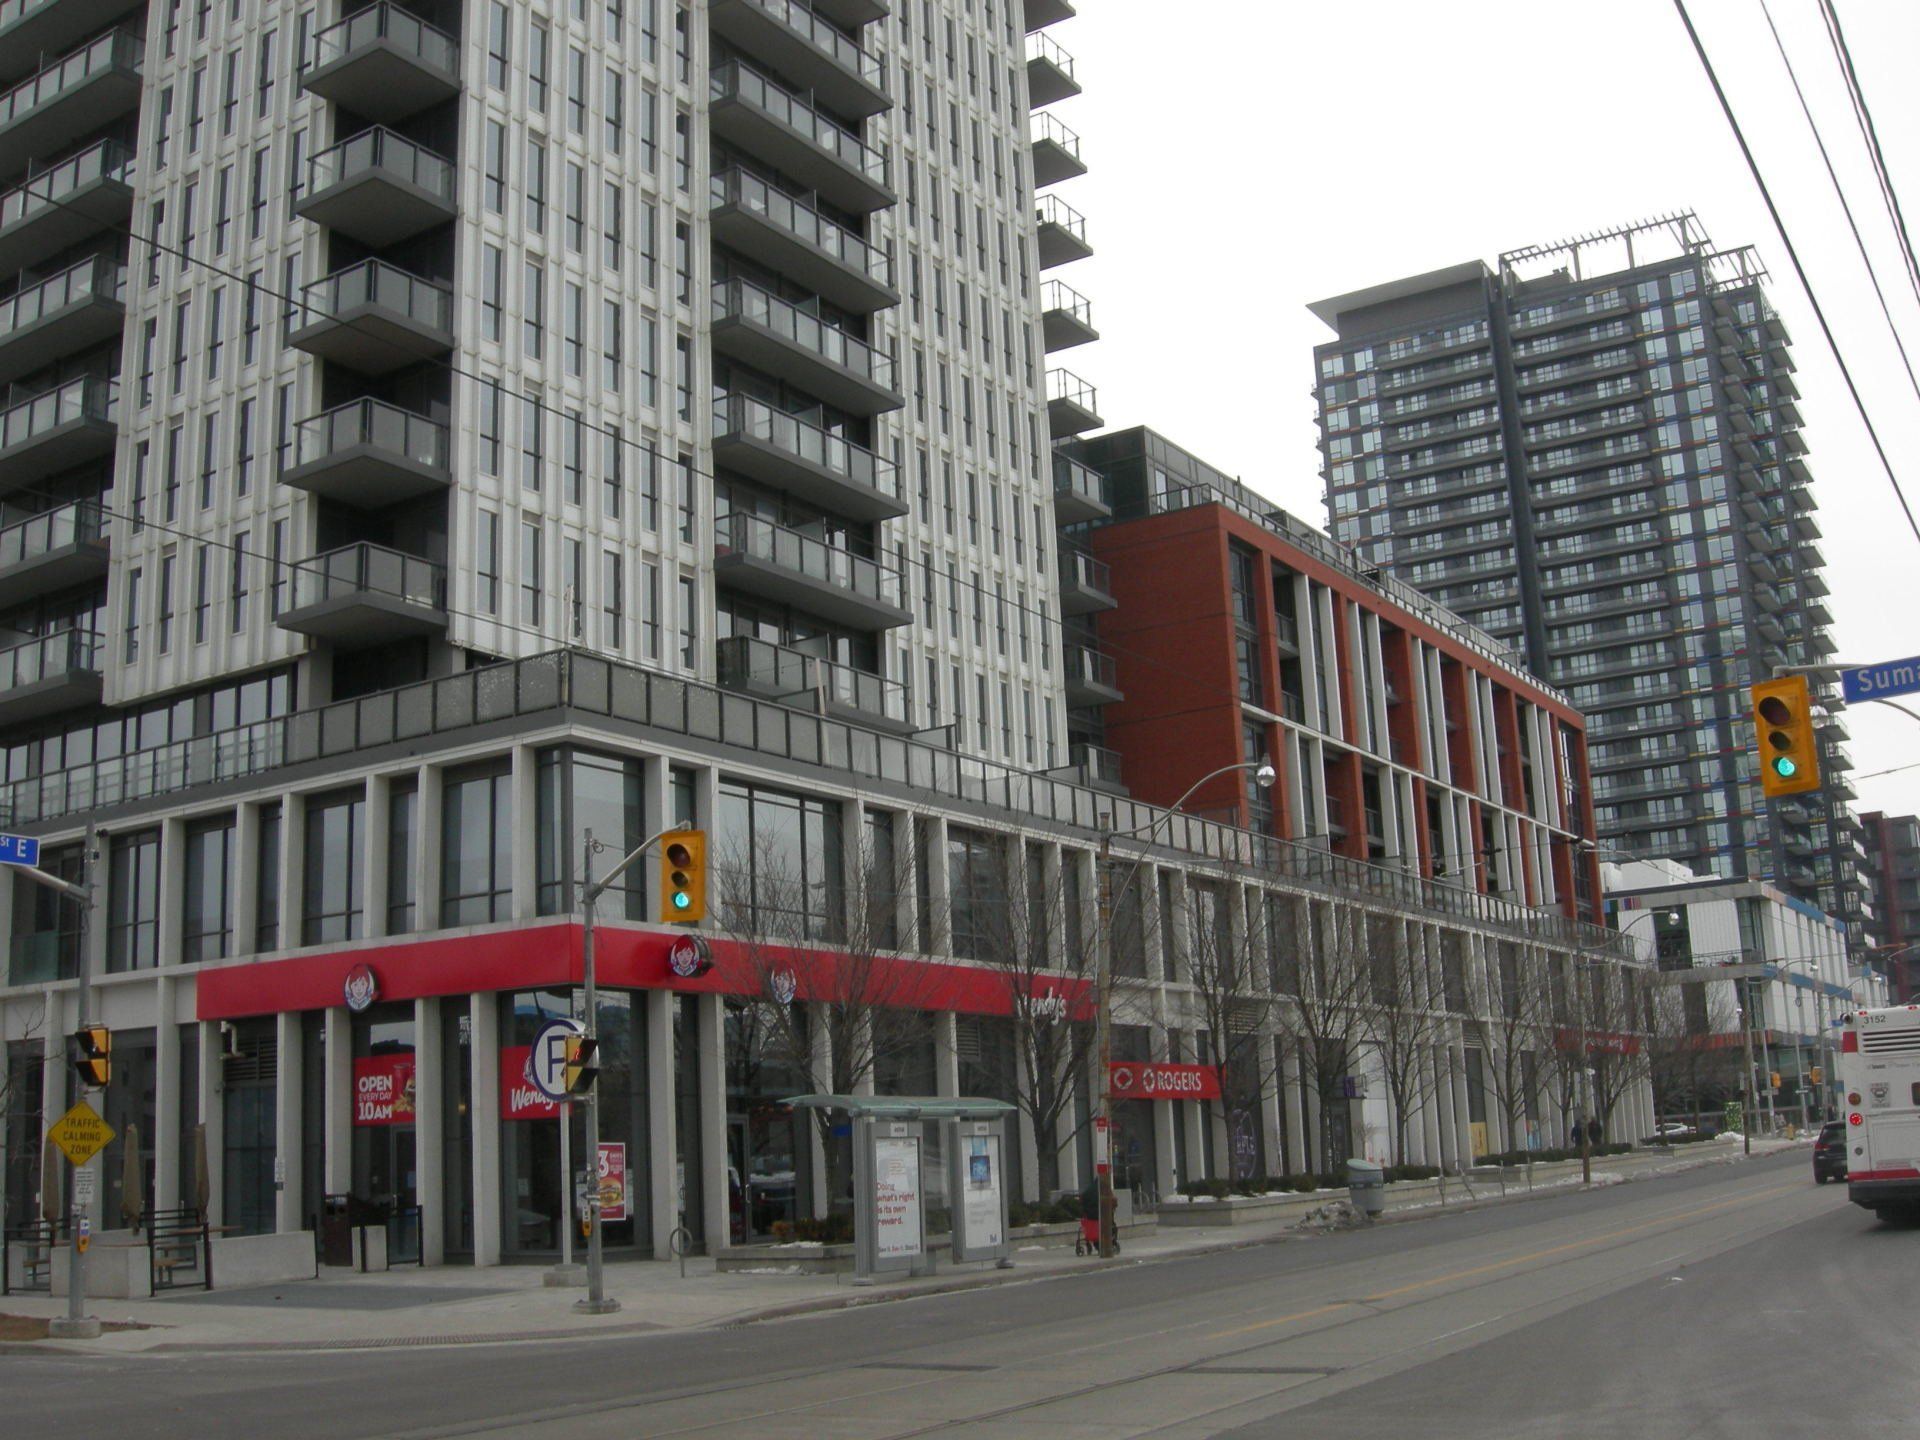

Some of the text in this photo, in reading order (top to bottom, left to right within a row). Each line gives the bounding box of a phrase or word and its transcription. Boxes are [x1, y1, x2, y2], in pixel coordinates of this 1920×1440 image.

[0, 836, 27, 858] St E
[1863, 1014, 1887, 1025] 3152
[358, 1074, 393, 1093] OPEN
[1157, 1070, 1202, 1092] ROGERS
[358, 1091, 392, 1103] EVERY DAY
[65, 1118, 100, 1129] TRAFFIC
[63, 1131, 101, 1142] CALMING
[70, 1144, 92, 1155] ZONE
[899, 1192, 915, 1202] right
[893, 1206, 906, 1214] own
